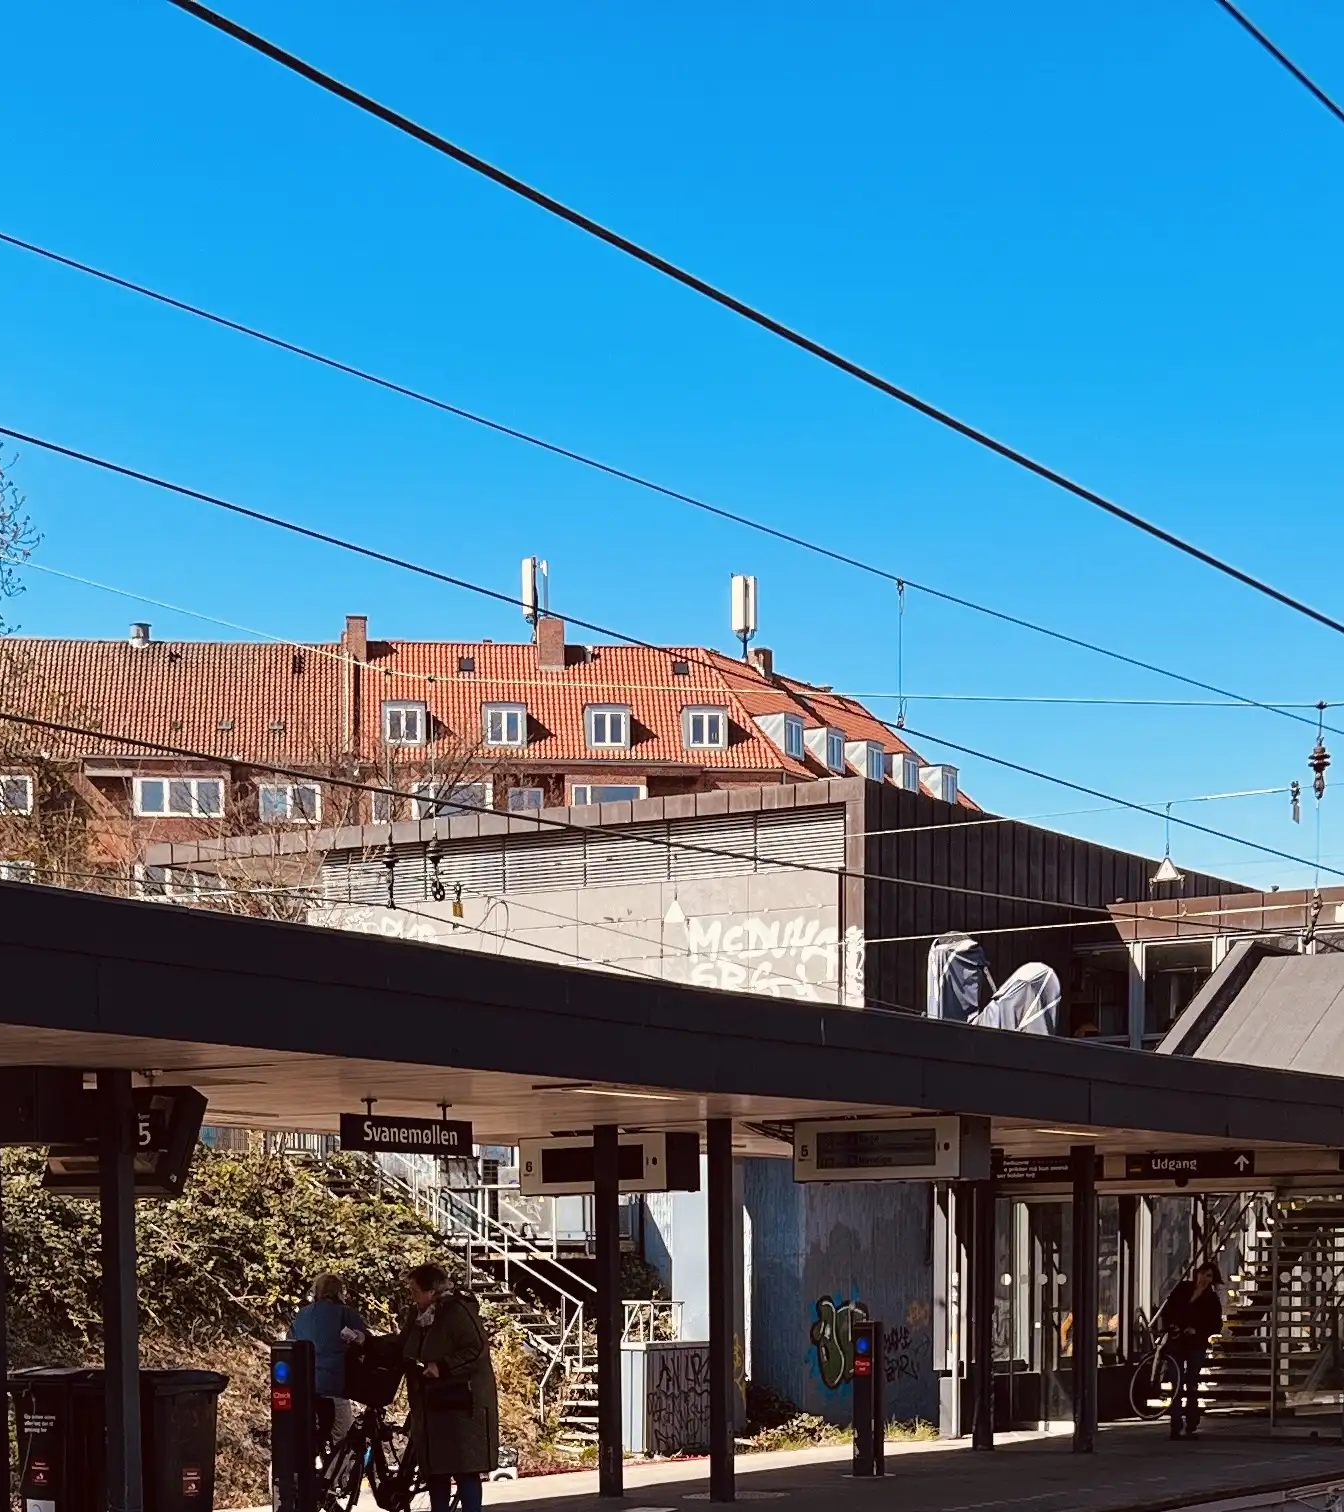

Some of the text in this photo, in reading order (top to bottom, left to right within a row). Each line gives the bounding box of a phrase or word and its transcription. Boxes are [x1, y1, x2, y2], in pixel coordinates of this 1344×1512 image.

[138, 1122, 152, 1146] 5
[363, 1120, 458, 1146] Svanemøllen
[525, 1161, 533, 1173] 6
[1151, 1158, 1197, 1171] Udgang
